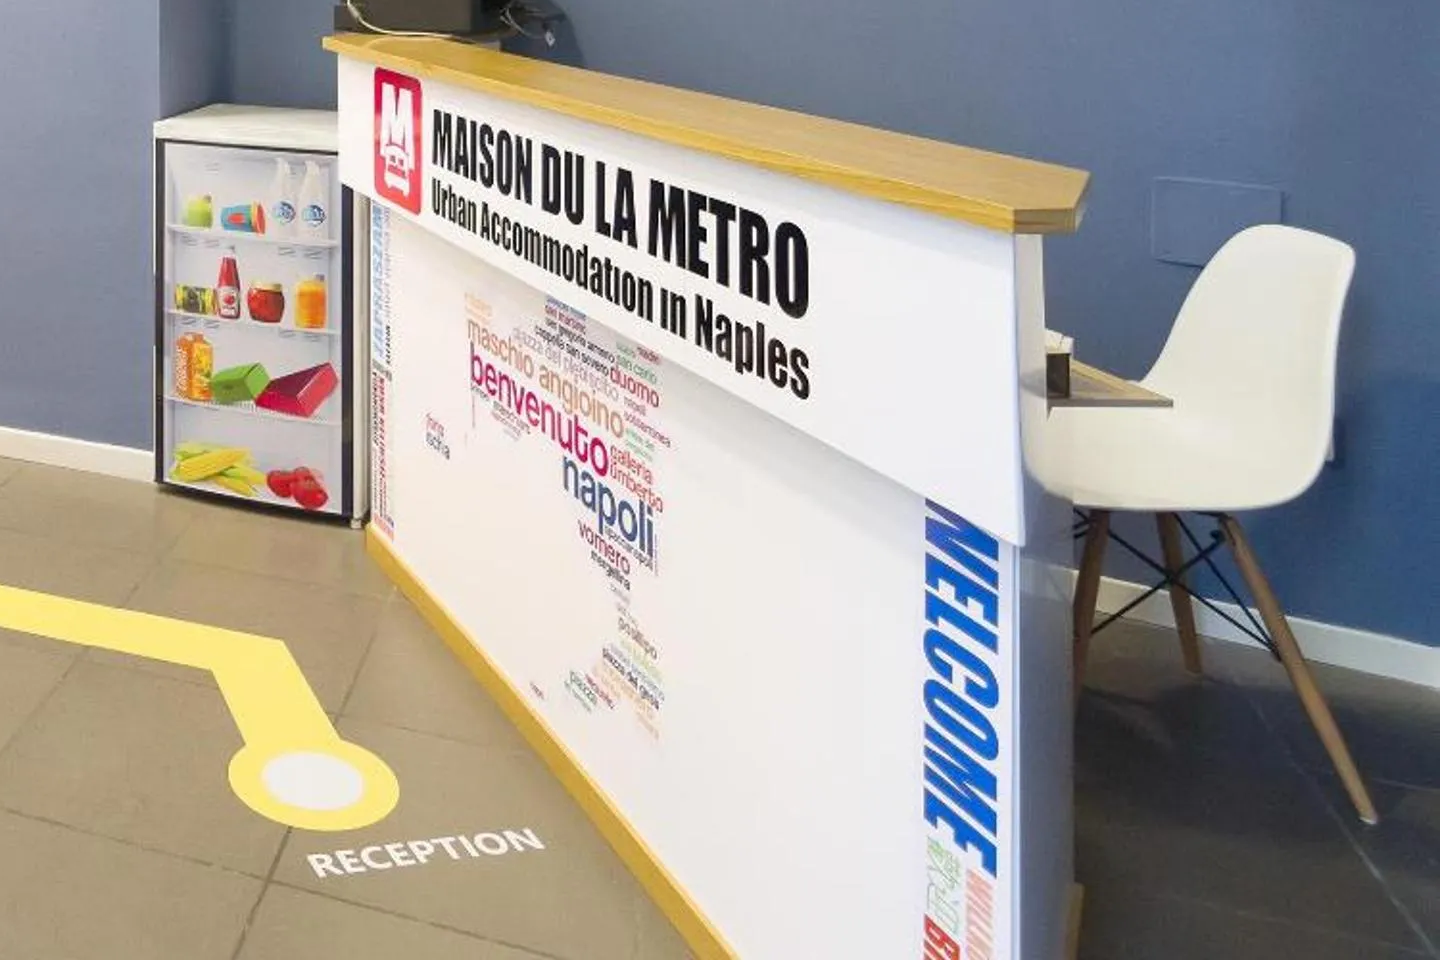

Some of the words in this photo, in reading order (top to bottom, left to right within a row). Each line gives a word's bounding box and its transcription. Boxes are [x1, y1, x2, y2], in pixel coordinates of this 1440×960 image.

[432, 109, 533, 206] MAISON
[541, 143, 585, 225] DU
[596, 160, 638, 249] LA
[648, 178, 810, 319] METRO
[432, 177, 478, 235] Urban
[480, 201, 655, 324] Accommodation
[695, 294, 810, 401] Naples
[467, 319, 534, 379] maschio
[539, 364, 625, 438] angioino
[469, 340, 610, 478] benvenuto
[610, 362, 660, 408] duomo
[563, 456, 655, 558] napoli
[578, 518, 631, 576] vomero
[923, 498, 1000, 880] WELCOME
[306, 827, 546, 879] RECEPTION
